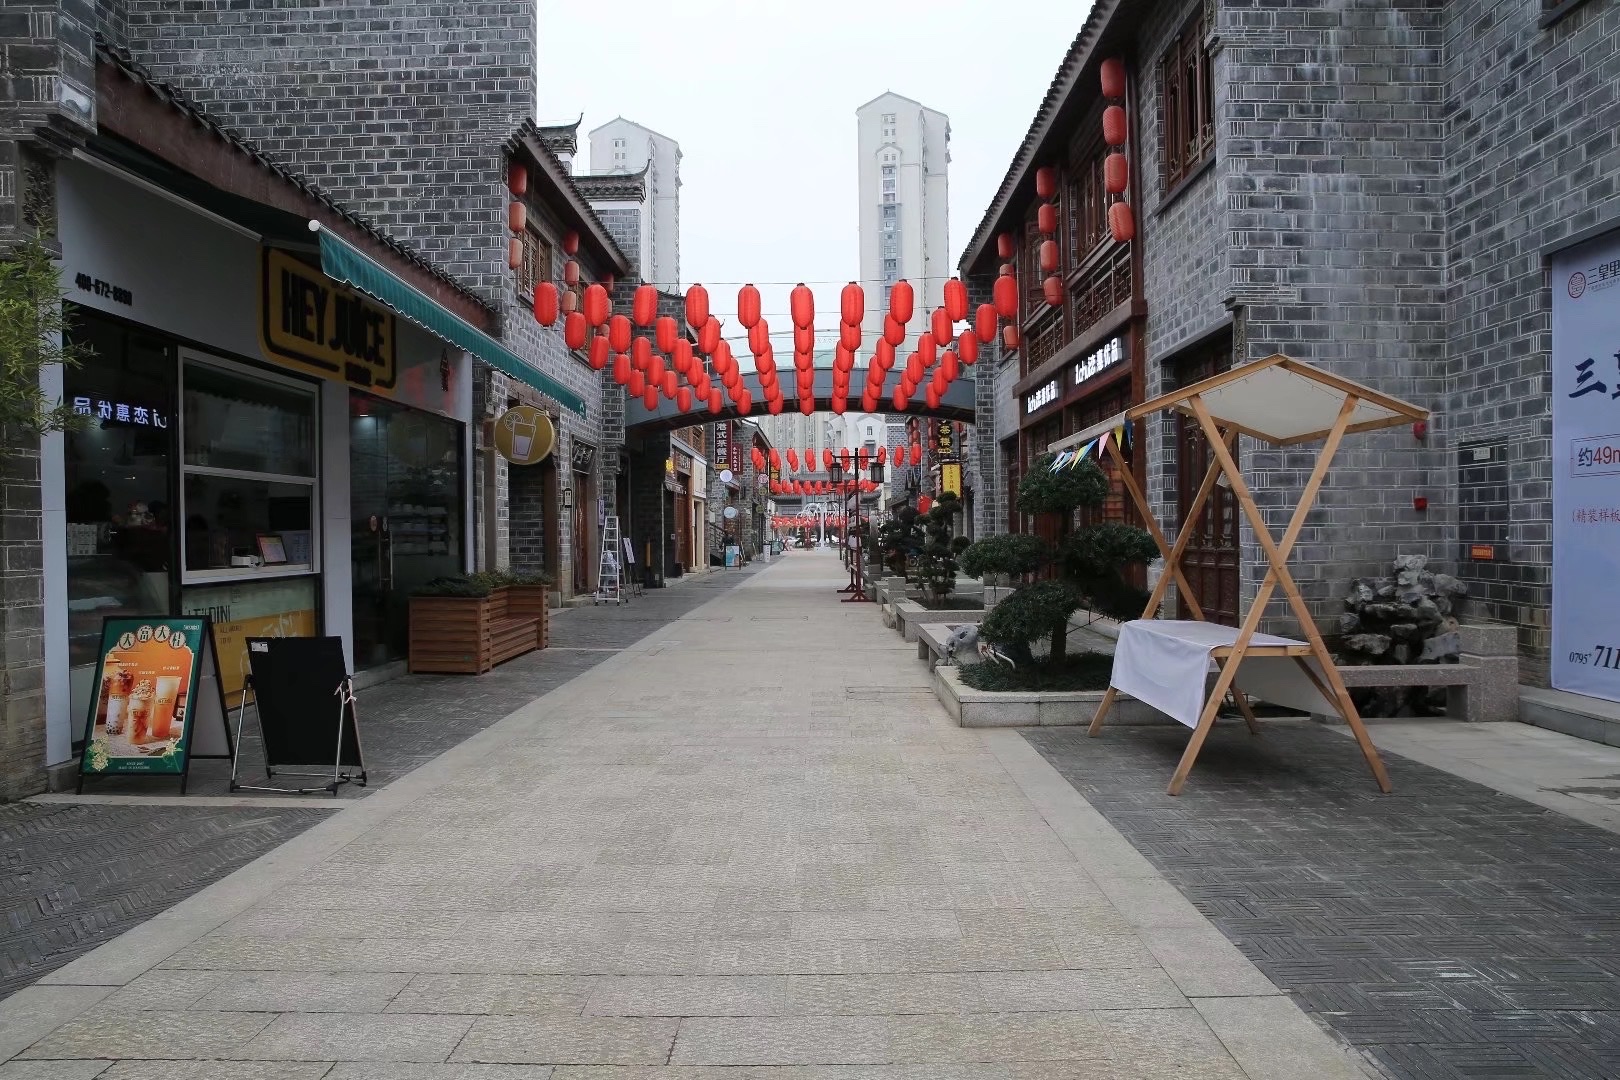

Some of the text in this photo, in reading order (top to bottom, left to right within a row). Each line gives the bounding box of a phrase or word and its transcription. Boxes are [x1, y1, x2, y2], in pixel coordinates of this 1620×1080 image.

[281, 267, 386, 367] HEY JUICE
[1568, 350, 1620, 399] 三
[716, 422, 727, 464] 港式茶餐厅
[121, 625, 183, 648] 大富大桂
